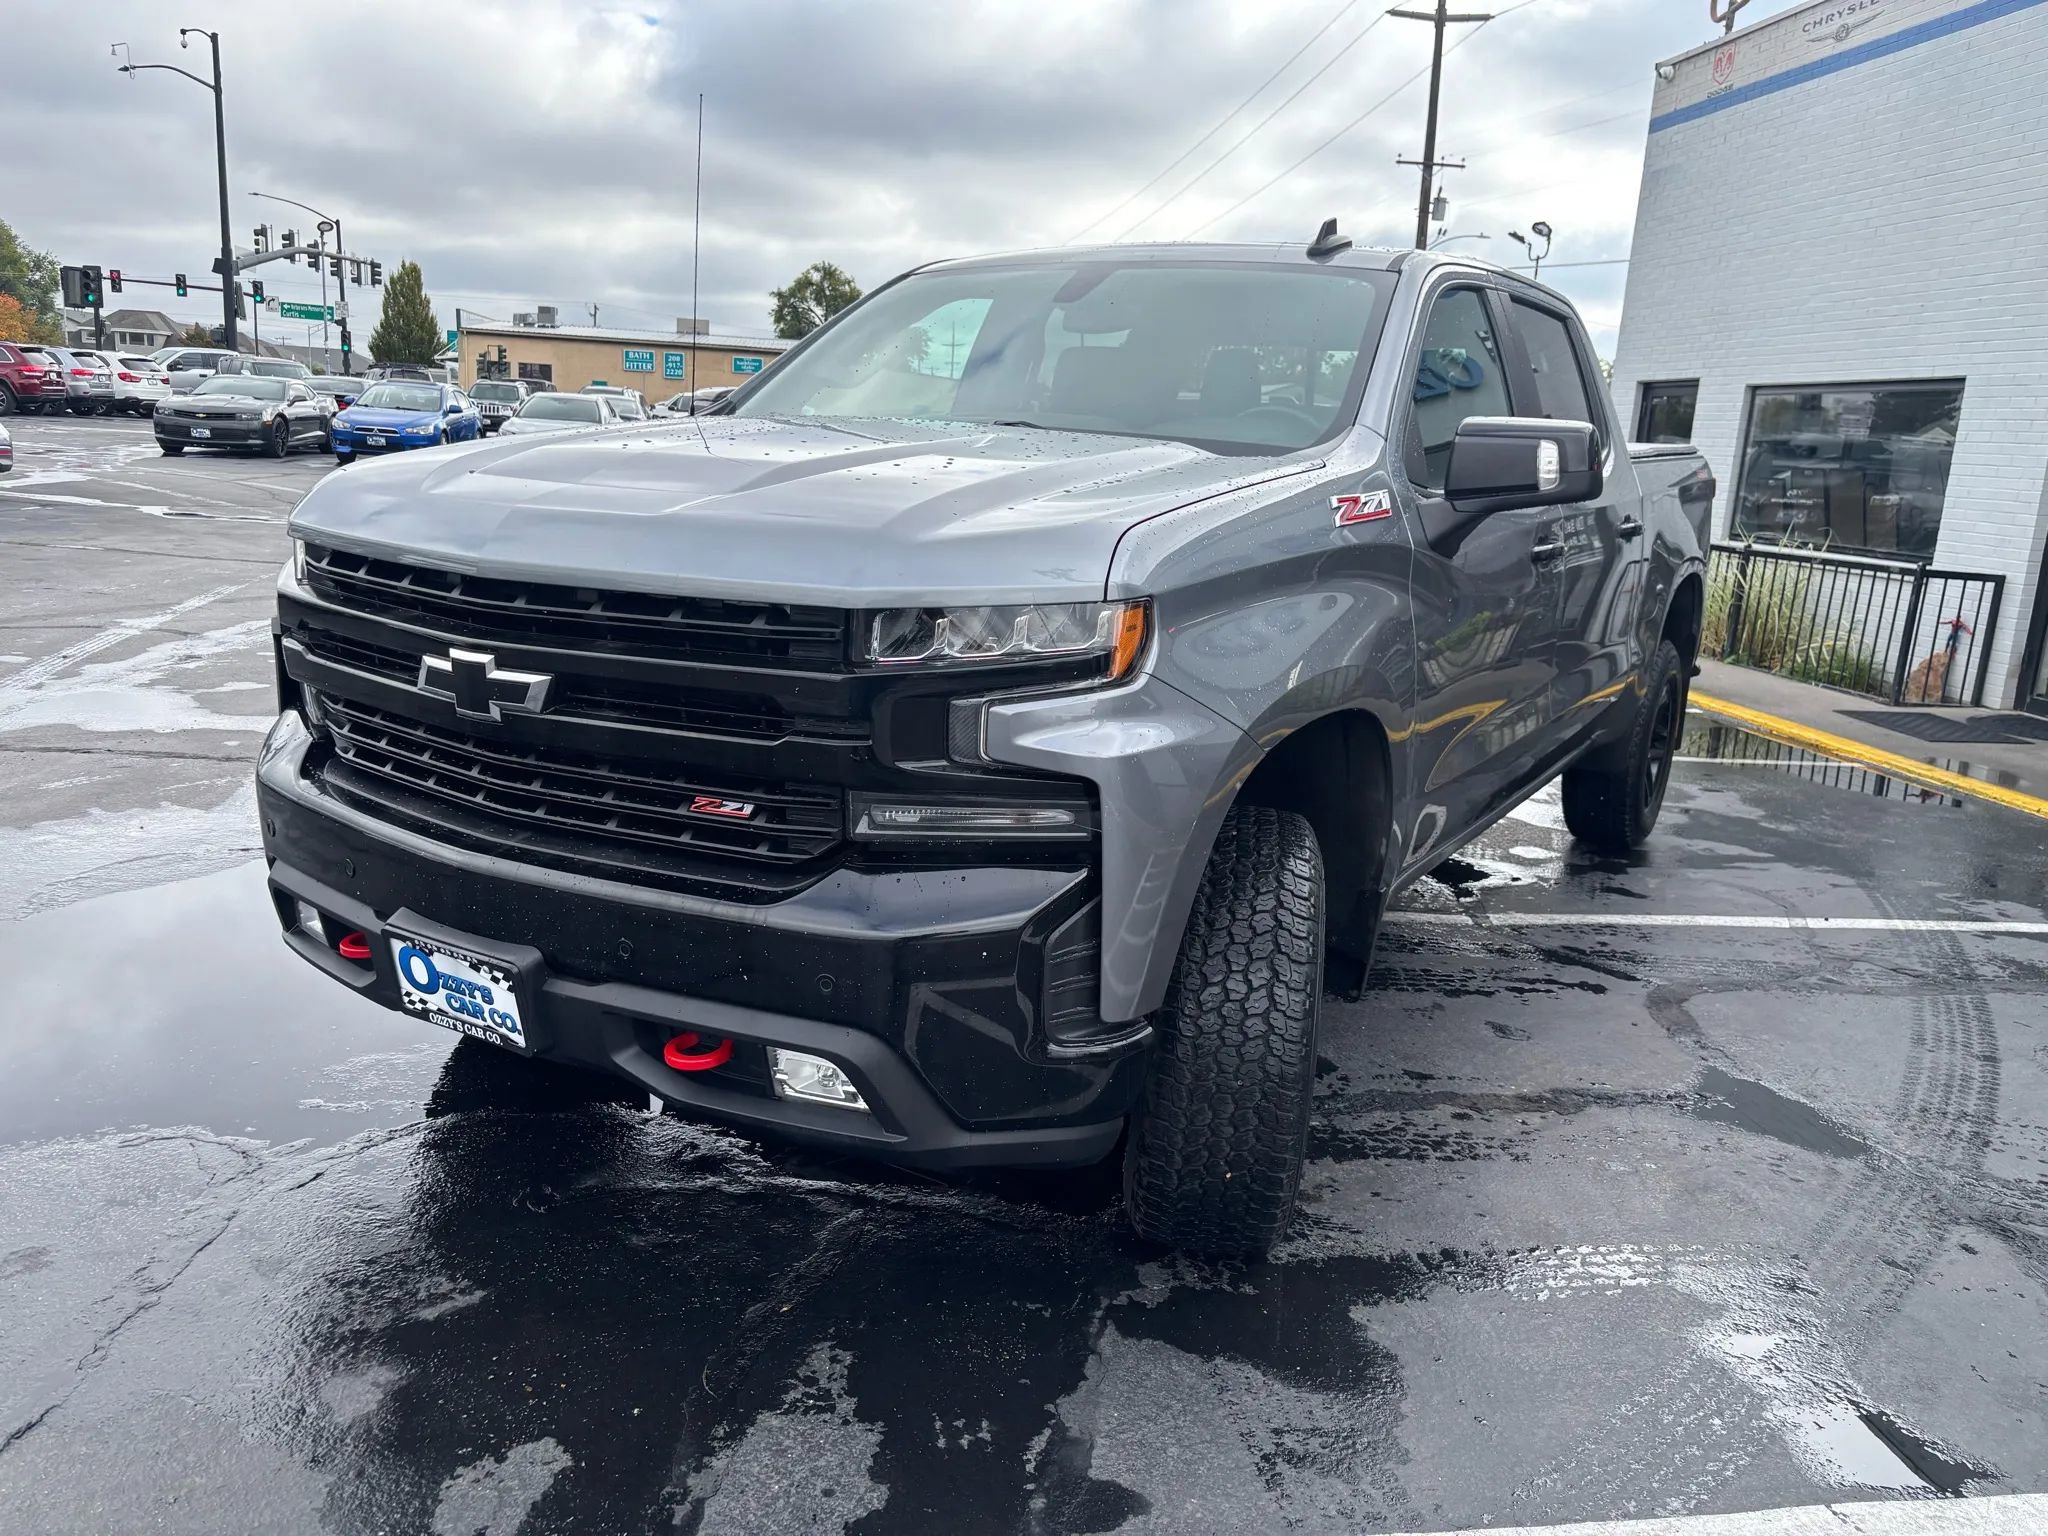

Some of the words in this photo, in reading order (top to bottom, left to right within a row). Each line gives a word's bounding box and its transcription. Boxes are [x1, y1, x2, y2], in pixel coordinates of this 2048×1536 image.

[282, 309, 299, 317] Curtis
[626, 361, 653, 370] FITTER
[628, 351, 650, 360] BATH
[1330, 489, 1392, 528] Z71
[689, 796, 755, 818] Z71
[445, 992, 488, 1023] CAR
[488, 1007, 523, 1037] CO.
[428, 1012, 464, 1032] OZZY'S
[464, 1023, 486, 1040] CAR
[485, 1031, 504, 1046] CO.
